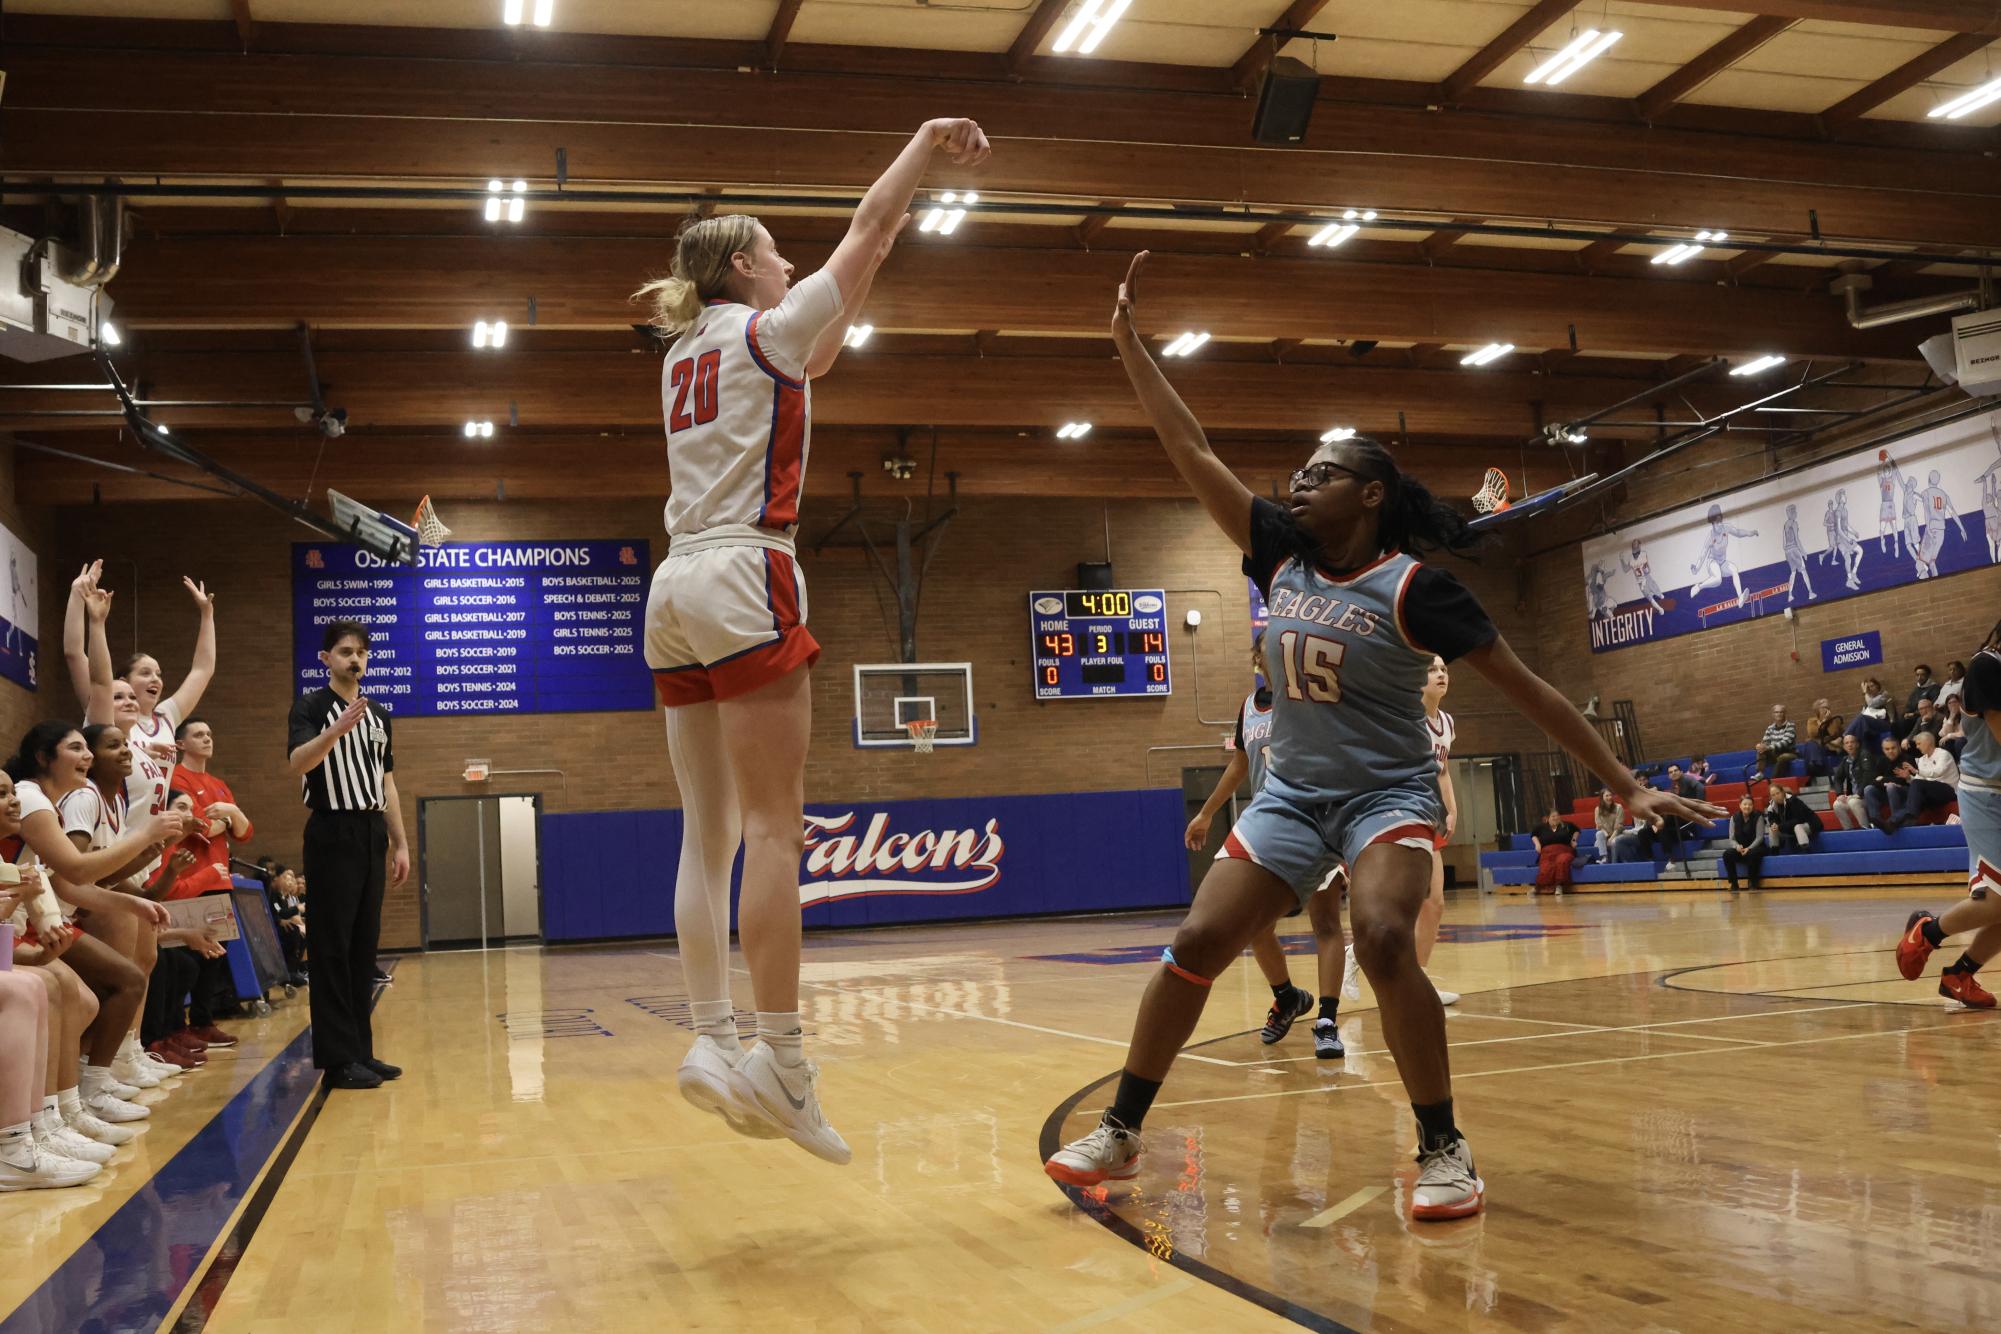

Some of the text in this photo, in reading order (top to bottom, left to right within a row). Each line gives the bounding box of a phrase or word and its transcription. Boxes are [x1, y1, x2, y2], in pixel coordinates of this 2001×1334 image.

[670, 349, 721, 434] 20
[474, 548, 590, 567] CHAMPIONS
[317, 580, 342, 589] GIRLS
[424, 579, 449, 588] GIRLS
[542, 577, 564, 586] BOYS
[313, 598, 336, 607] BOYS
[433, 596, 458, 605] GIRLS
[544, 594, 575, 603] SPEECH
[576, 594, 583, 603] &
[1082, 593, 1129, 615] 4:00
[554, 611, 576, 621] BOYS
[1270, 588, 1380, 636] EAGLES
[314, 615, 337, 624] BOYS
[424, 613, 449, 623] GIRLS
[1040, 620, 1069, 631] HOME
[1128, 618, 1159, 630] GUEST
[1591, 607, 1653, 649] INTEGRITY
[553, 628, 578, 638] GIRLS
[1088, 625, 1112, 633] PERIOD
[425, 631, 449, 640] GIRLS
[1045, 633, 1073, 656] 43
[1097, 635, 1107, 653] 3
[1143, 633, 1163, 652] 14
[1835, 639, 1865, 653] GENERAL
[435, 648, 458, 657] BOYS
[553, 646, 576, 655] BOYS
[1081, 657, 1124, 665] PLAYER FOUL
[1145, 655, 1166, 664] FOULS
[1833, 649, 1870, 665] ADMISSION
[1038, 658, 1060, 666] FOULS
[1280, 629, 1347, 704] 15
[301, 669, 324, 678] GIRLS
[436, 666, 459, 675] BOYS
[1153, 664, 1164, 681] 0
[1046, 667, 1057, 684] 0
[437, 683, 460, 693] BOYS
[1039, 688, 1061, 696] SCORE
[1092, 686, 1116, 694] MATCH
[1146, 684, 1167, 693] SCORE
[436, 701, 459, 710] BOYS
[802, 811, 1004, 877] Falcons
